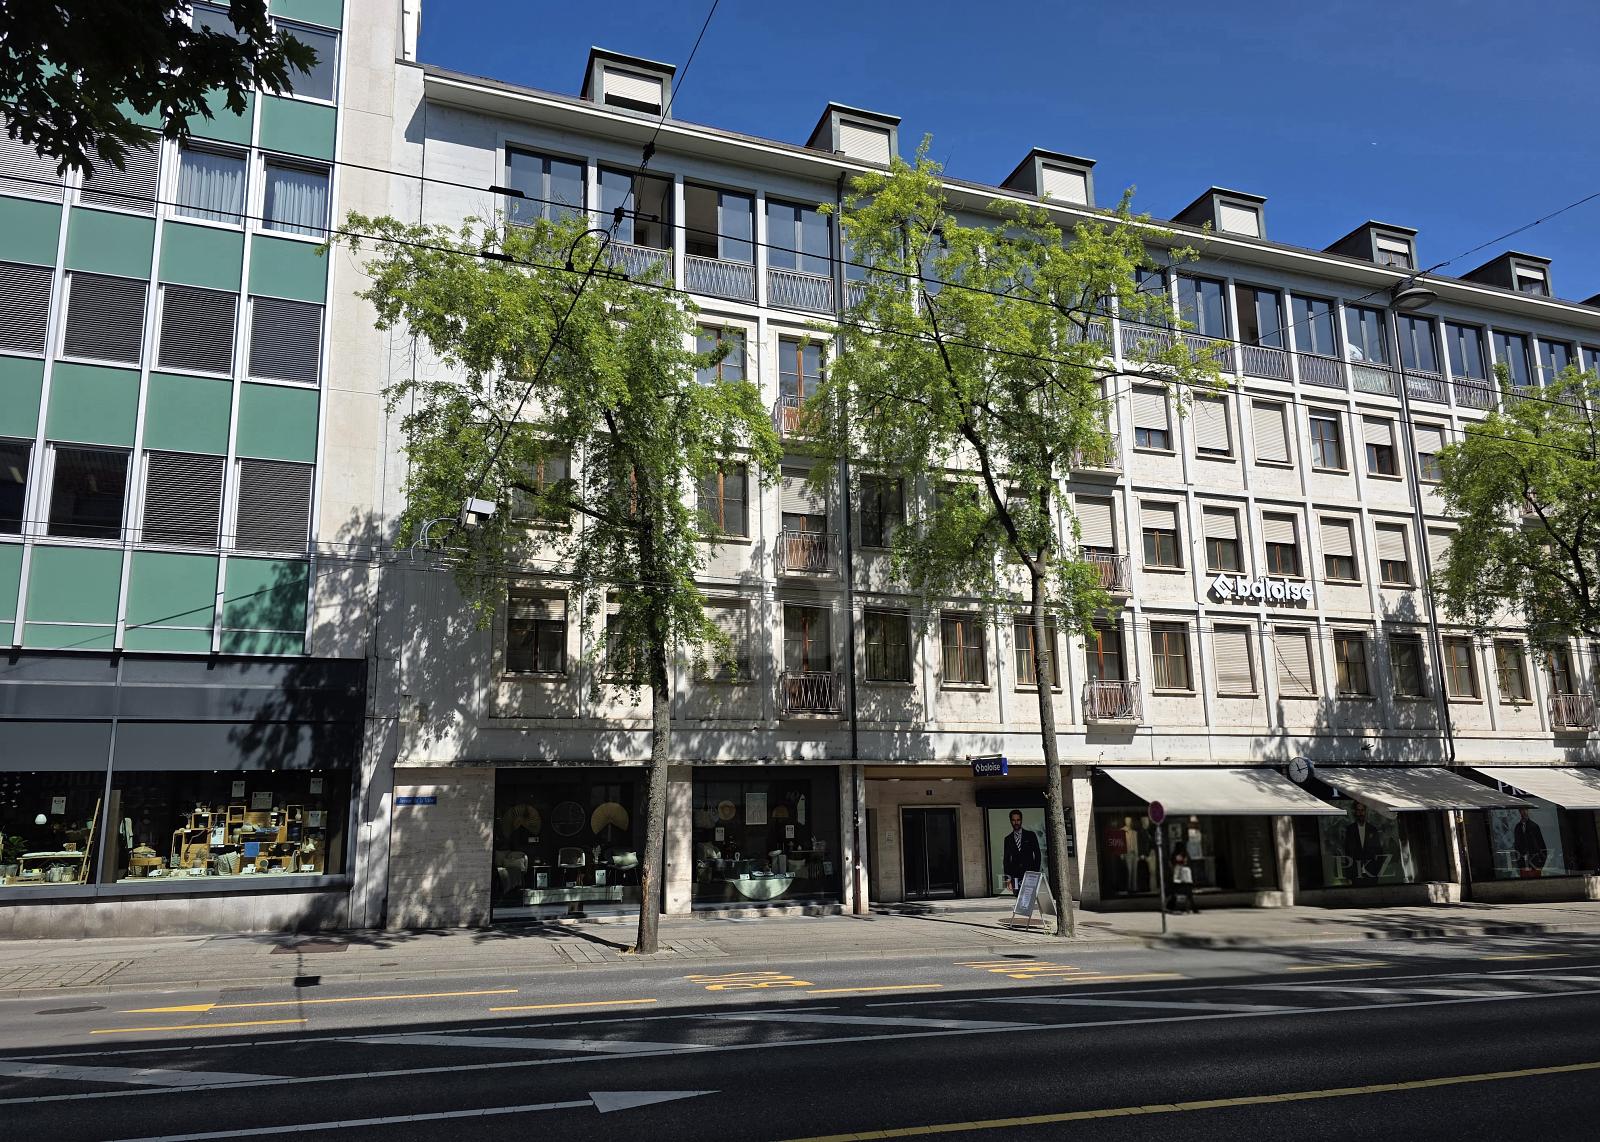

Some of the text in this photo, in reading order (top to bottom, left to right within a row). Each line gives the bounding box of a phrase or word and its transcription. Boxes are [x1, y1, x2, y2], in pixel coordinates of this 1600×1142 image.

[1236, 575, 1314, 601] baloise
[980, 761, 1001, 772] baloise
[1497, 780, 1529, 795] PK
[1332, 853, 1396, 880] PKZ
[683, 971, 816, 991] BUS
